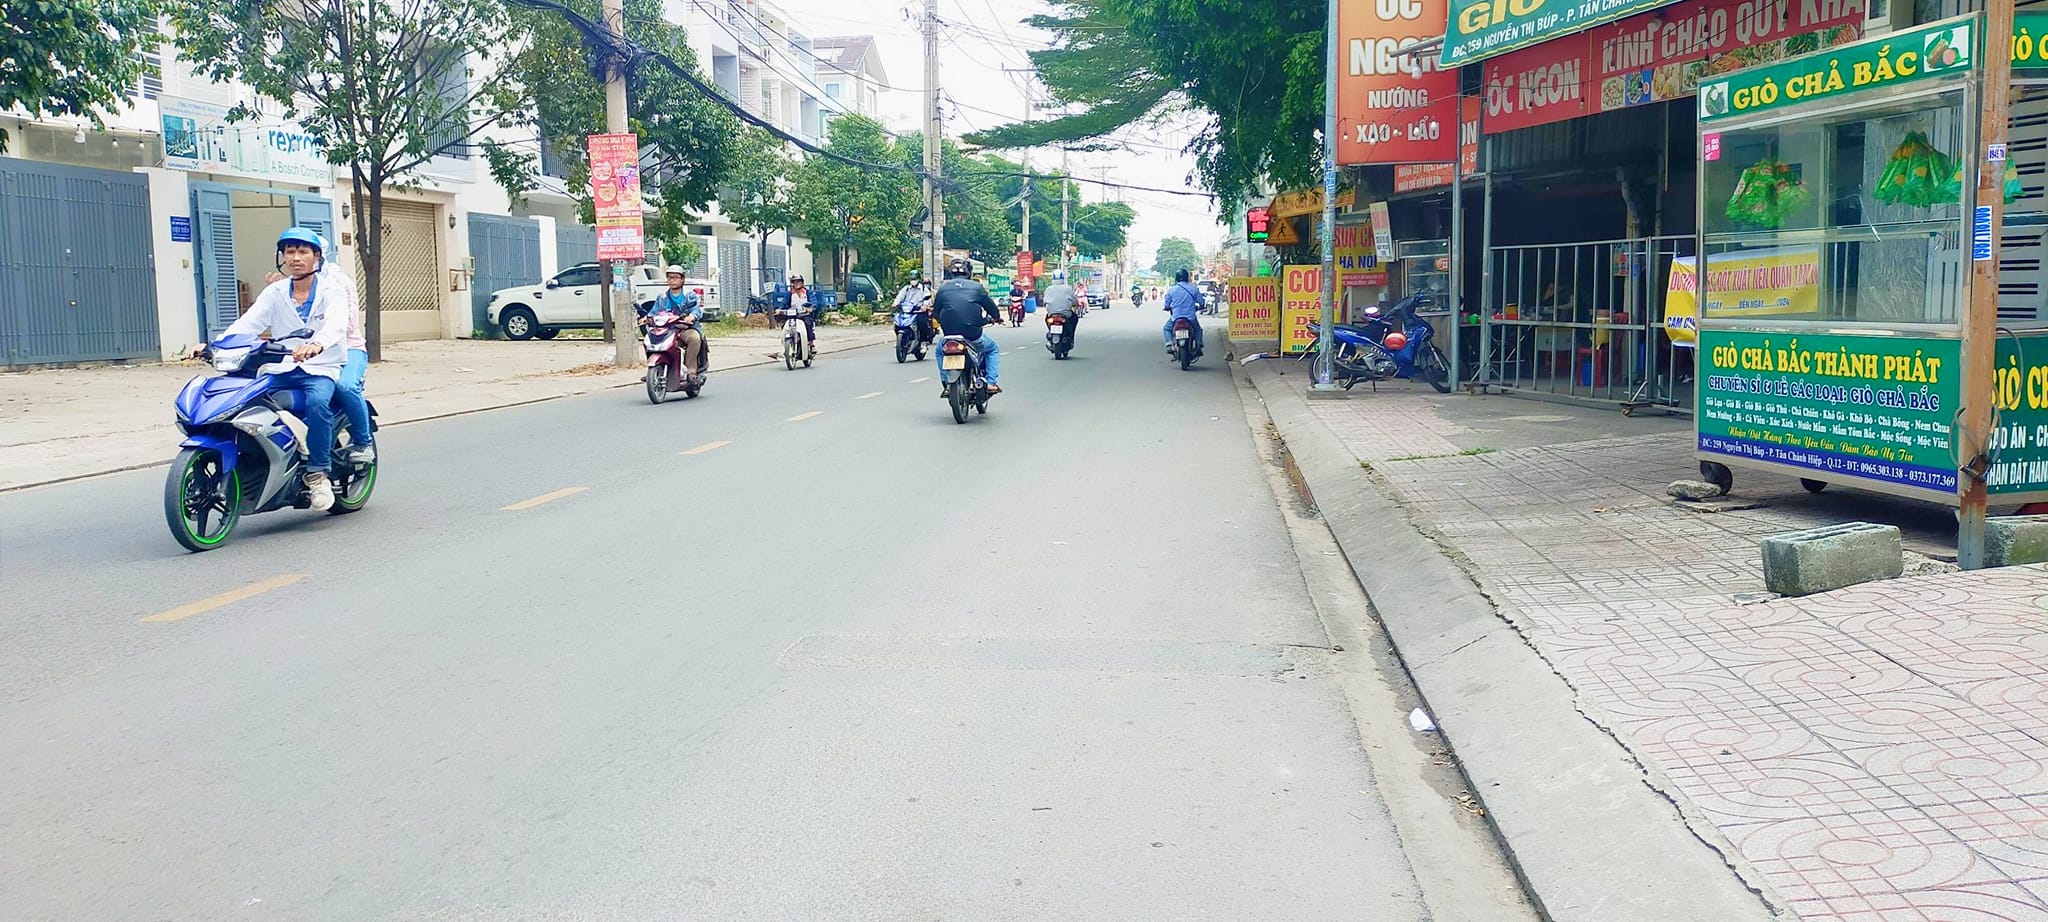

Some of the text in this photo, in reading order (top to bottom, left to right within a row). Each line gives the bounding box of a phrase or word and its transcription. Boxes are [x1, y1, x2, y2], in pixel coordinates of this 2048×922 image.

[1483, 23, 1519, 48] NGUYỄN
[1520, 24, 1534, 37] THỊ
[1537, 12, 1557, 32] BÚP
[1566, 9, 1576, 21] P.
[1579, 0, 1598, 18] TÂN
[1602, 27, 1652, 74] KÍNH
[1661, 8, 1727, 57] CHÀO
[2011, 27, 2033, 61] IÒ
[1487, 58, 1580, 117] ỐC NGON
[1733, 45, 1916, 110] GIÒ CHẢ BẮC
[1368, 86, 1428, 109] NƯỚNG
[1356, 121, 1391, 142] XÀO
[1407, 115, 1440, 141] LẨU
[278, 161, 299, 175] Bosch
[300, 164, 331, 183] Company
[1340, 252, 1377, 271] HÀ NỘI
[1231, 279, 1276, 303] BÚN CHẢ
[1718, 267, 1731, 296] ĐỘT
[1733, 262, 1751, 292] XUẤT
[1753, 264, 1769, 290] NÊN
[1771, 261, 1792, 291] QUÁN
[1236, 306, 1271, 320] HÀ NỘI
[1713, 339, 1941, 383] GIÒ CHẢ BẮC THÀNH PHÁT
[1708, 374, 1940, 412] CHUYÊN SỈ & LẺ CÁC LOẠI: GIÒ CHẢ BẮC
[1848, 426, 1862, 438] Tôm
[1895, 431, 1912, 446] Sống
[1917, 435, 1932, 449] Mộc
[1933, 436, 1949, 449] Viên
[1850, 412, 1863, 423] Khô
[1892, 417, 1910, 431] Bông
[1915, 419, 1931, 431] Nem
[1932, 421, 1950, 433] Chua
[2010, 421, 2026, 449] ĂN
[1775, 449, 1787, 460] Tân
[1787, 451, 1807, 463] Chánh
[1807, 453, 1822, 468] Hiệp
[1827, 457, 1842, 469] Q.12
[1846, 460, 1860, 471] ĐT:
[1860, 462, 1904, 478] 0965.303.138
[1909, 470, 1956, 487] 0373.177.369
[2010, 457, 2028, 489] ĐẶT
